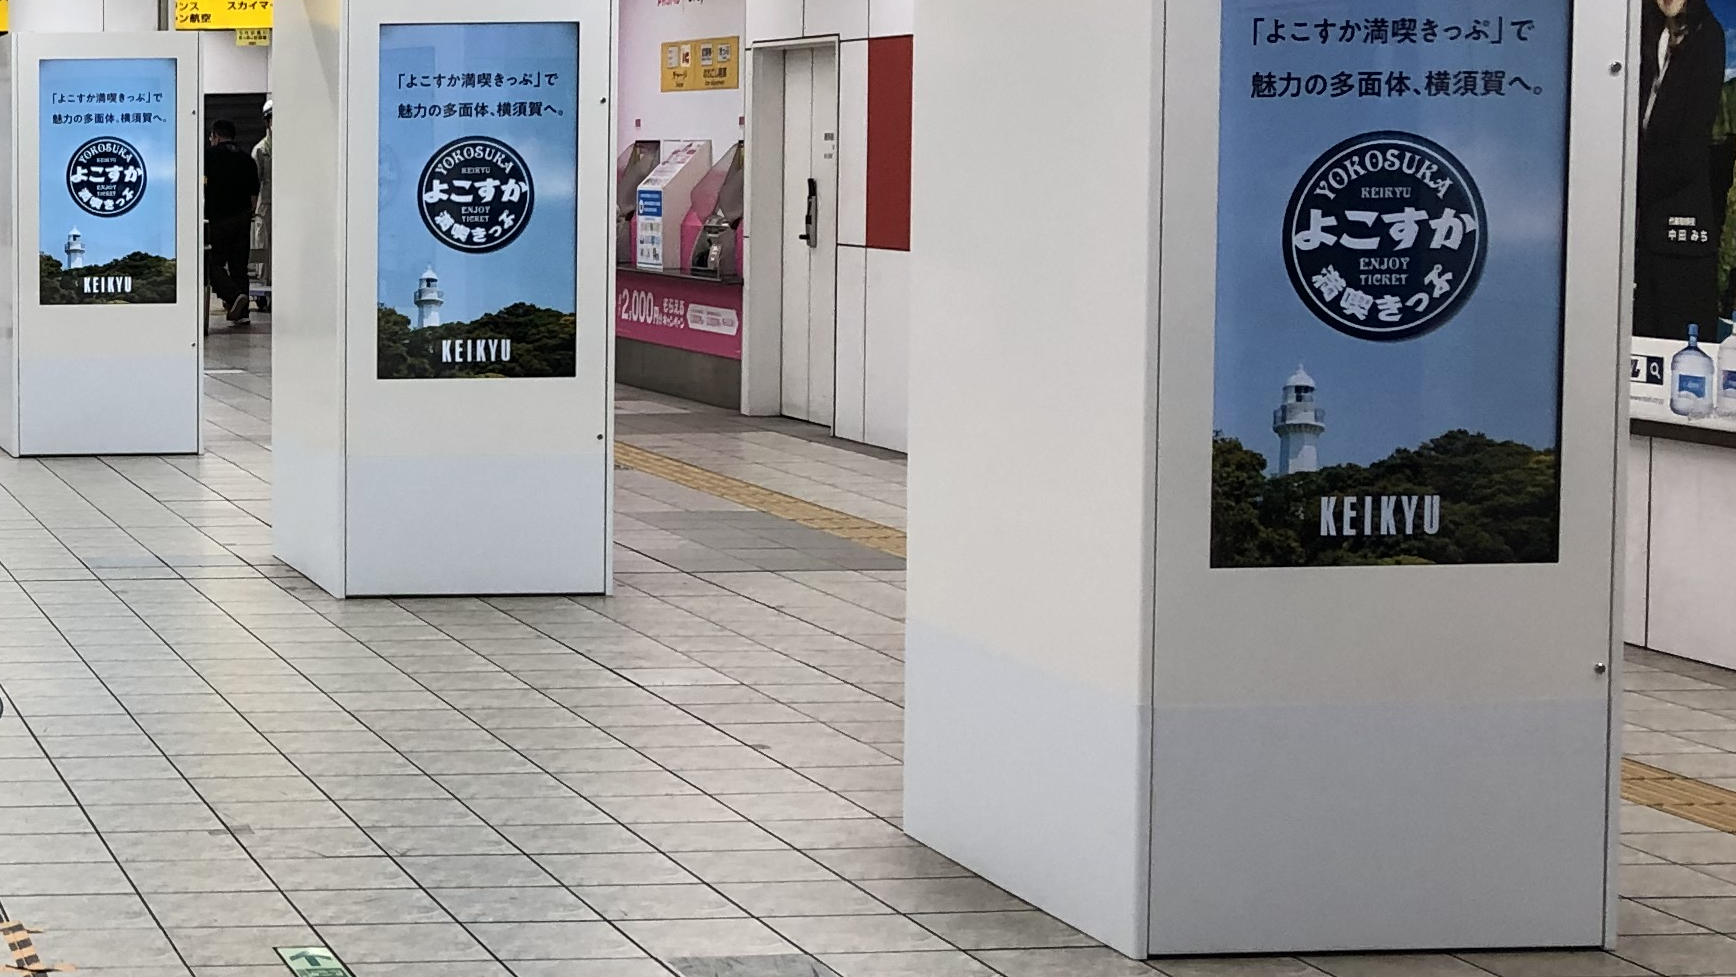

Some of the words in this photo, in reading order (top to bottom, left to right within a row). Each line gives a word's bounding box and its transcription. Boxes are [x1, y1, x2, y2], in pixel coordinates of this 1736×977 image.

[176, 1, 199, 11] ンス
[227, 1, 273, 11] スカイマ
[176, 13, 212, 23] ン航空
[1251, 16, 1535, 46] 「よこすか満喫きっぷ」で
[1250, 70, 1544, 99] 魅力の多面体、横須賀へ。
[398, 102, 564, 118] 魅力の多面体、横須賀へ。
[78, 143, 132, 163] YOKOSUKA
[435, 146, 514, 175] YOKOSUKA
[70, 165, 143, 183] よこすか
[1314, 149, 1454, 200] YOKOSUKA
[424, 178, 528, 203] よこすか
[1361, 187, 1412, 199] KEIKYU
[1294, 207, 1477, 251] よこすか
[1359, 257, 1410, 270] ENJOY
[83, 276, 133, 294] KEIKYU
[1360, 274, 1407, 285] TICKET
[1312, 264, 1453, 322] 満喫きっぷ
[441, 339, 512, 364] KEIKYU
[1320, 495, 1442, 537] KEIKYU
